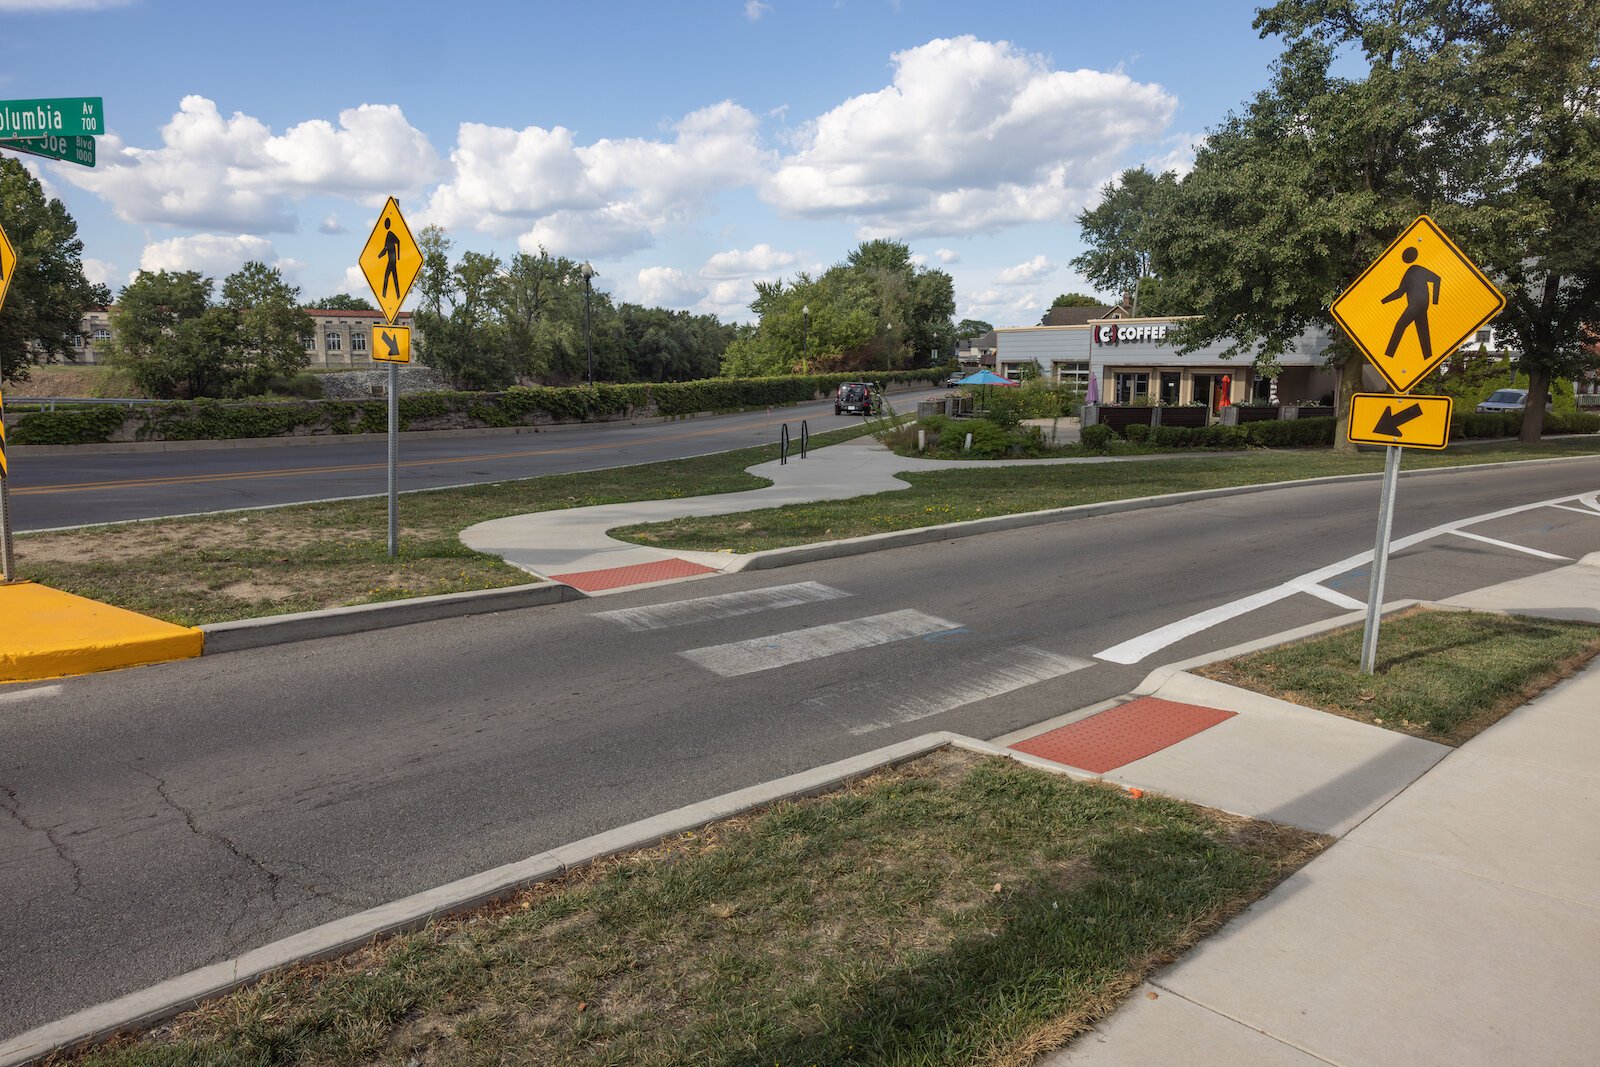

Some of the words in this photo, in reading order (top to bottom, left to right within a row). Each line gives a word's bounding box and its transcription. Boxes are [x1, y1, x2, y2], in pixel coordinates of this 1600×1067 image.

[82, 102, 93, 114] Av
[81, 117, 96, 130] 700
[40, 136, 67, 154] Joe
[76, 136, 92, 150] Blvd
[76, 148, 92, 163] 1000
[1117, 326, 1167, 340] COFFEE
